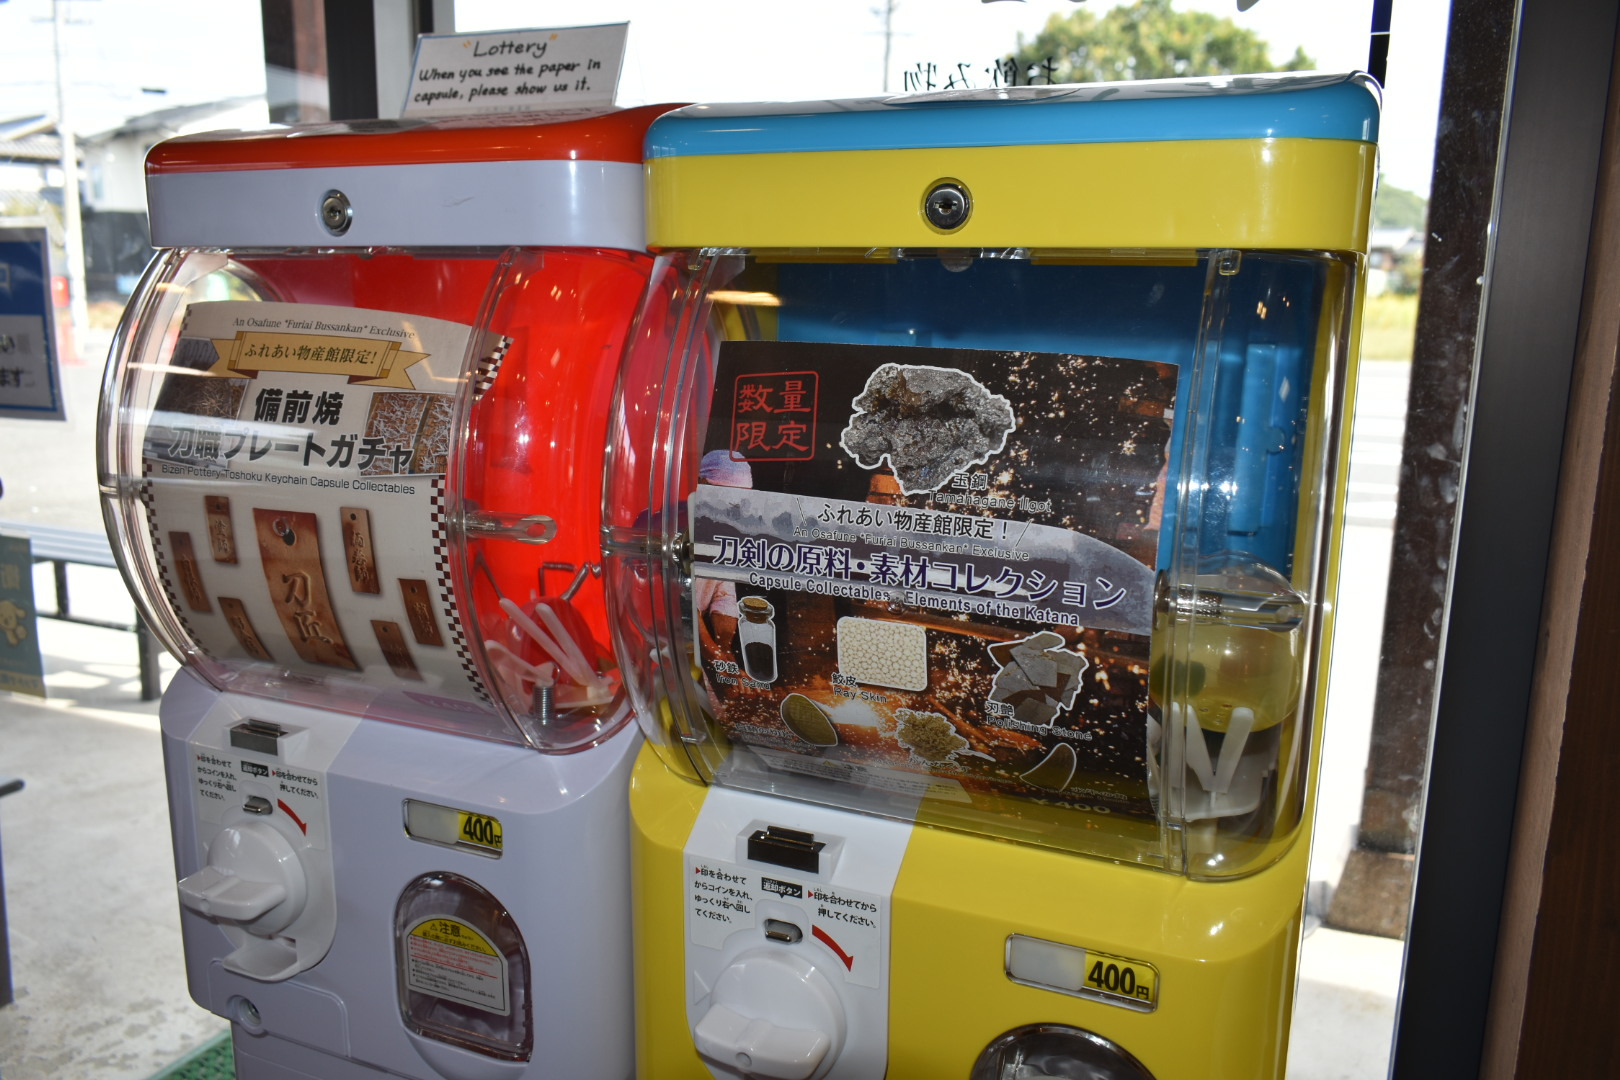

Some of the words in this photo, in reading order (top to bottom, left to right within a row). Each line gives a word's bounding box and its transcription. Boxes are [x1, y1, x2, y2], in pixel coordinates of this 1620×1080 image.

[473, 39, 548, 59] Lottery
[419, 67, 455, 81] When
[459, 69, 482, 83] you
[486, 66, 509, 77] see
[514, 62, 534, 76] the
[538, 61, 581, 78] paper
[587, 58, 601, 71] in
[414, 87, 463, 106] capsule,
[468, 84, 508, 102] please
[514, 82, 547, 95] show
[553, 83, 568, 92] us
[575, 76, 591, 91] it.
[232, 317, 245, 327] An
[246, 317, 282, 329] Osafune
[369, 325, 415, 340] Exclusive
[254, 387, 344, 425] 備前焼
[738, 379, 812, 413] 数量
[735, 420, 810, 452] 限定
[162, 464, 186, 475] Bizen
[265, 473, 308, 486] Keychain
[310, 476, 349, 490] Capsule
[352, 479, 415, 496] Collectables
[952, 472, 989, 491] 玉鋼
[928, 489, 1016, 509] Tamahagane
[793, 526, 808, 538] An
[811, 528, 857, 543] Osafune
[972, 545, 1030, 562] Exclusive
[712, 534, 1127, 609] 刀剣の原料・素材コレクション
[749, 572, 802, 590] Capsule
[806, 579, 891, 602] Collectables
[904, 590, 972, 612] Elements
[976, 600, 992, 615] of
[996, 602, 1021, 618] the
[1024, 606, 1080, 626] Katana
[834, 687, 857, 701] Ray
[861, 690, 888, 704] Skin
[987, 715, 1048, 736] Polishing
[1052, 726, 1092, 741] Stone
[701, 868, 747, 885] 印を合わせて
[694, 880, 753, 901] からコインを入れ、
[694, 894, 751, 914] ゆっくり右へ回し
[814, 892, 877, 913] 印を合わせてから
[695, 908, 732, 924] てください。
[818, 907, 876, 929] 押してください。
[439, 921, 460, 937] 注意
[1088, 961, 1150, 1000] 400円
